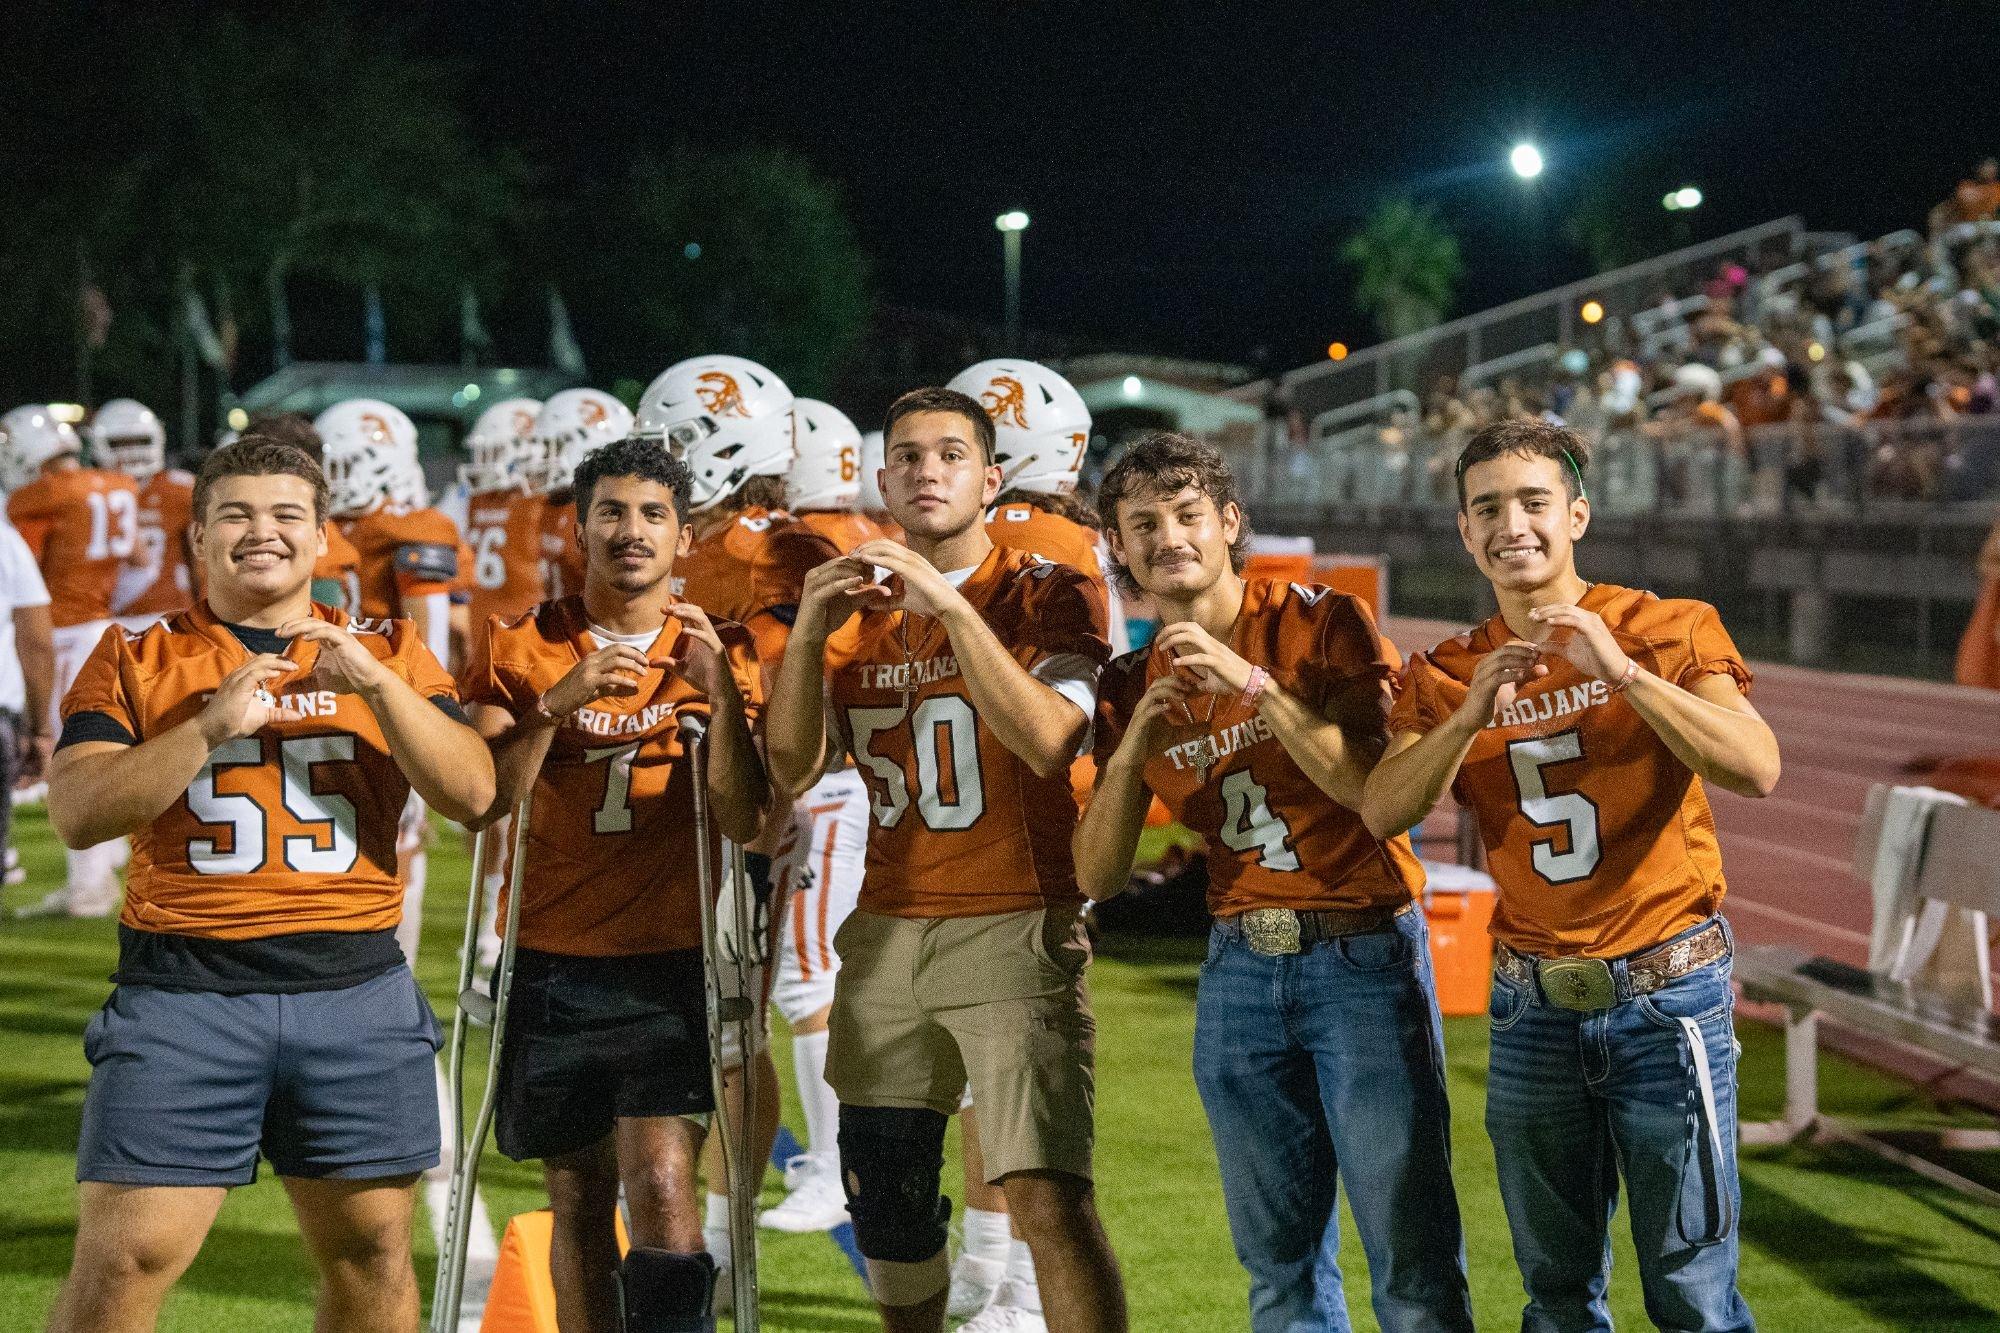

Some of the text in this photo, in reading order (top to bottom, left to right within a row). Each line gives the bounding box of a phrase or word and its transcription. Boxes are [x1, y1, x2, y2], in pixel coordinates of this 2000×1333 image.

[84, 490, 137, 561] 13
[1487, 680, 1609, 729] ROJANS
[186, 734, 358, 875] 55
[583, 741, 642, 834] 7
[848, 694, 984, 830] 50
[1506, 731, 1603, 887] 5
[1221, 768, 1301, 872] 4
